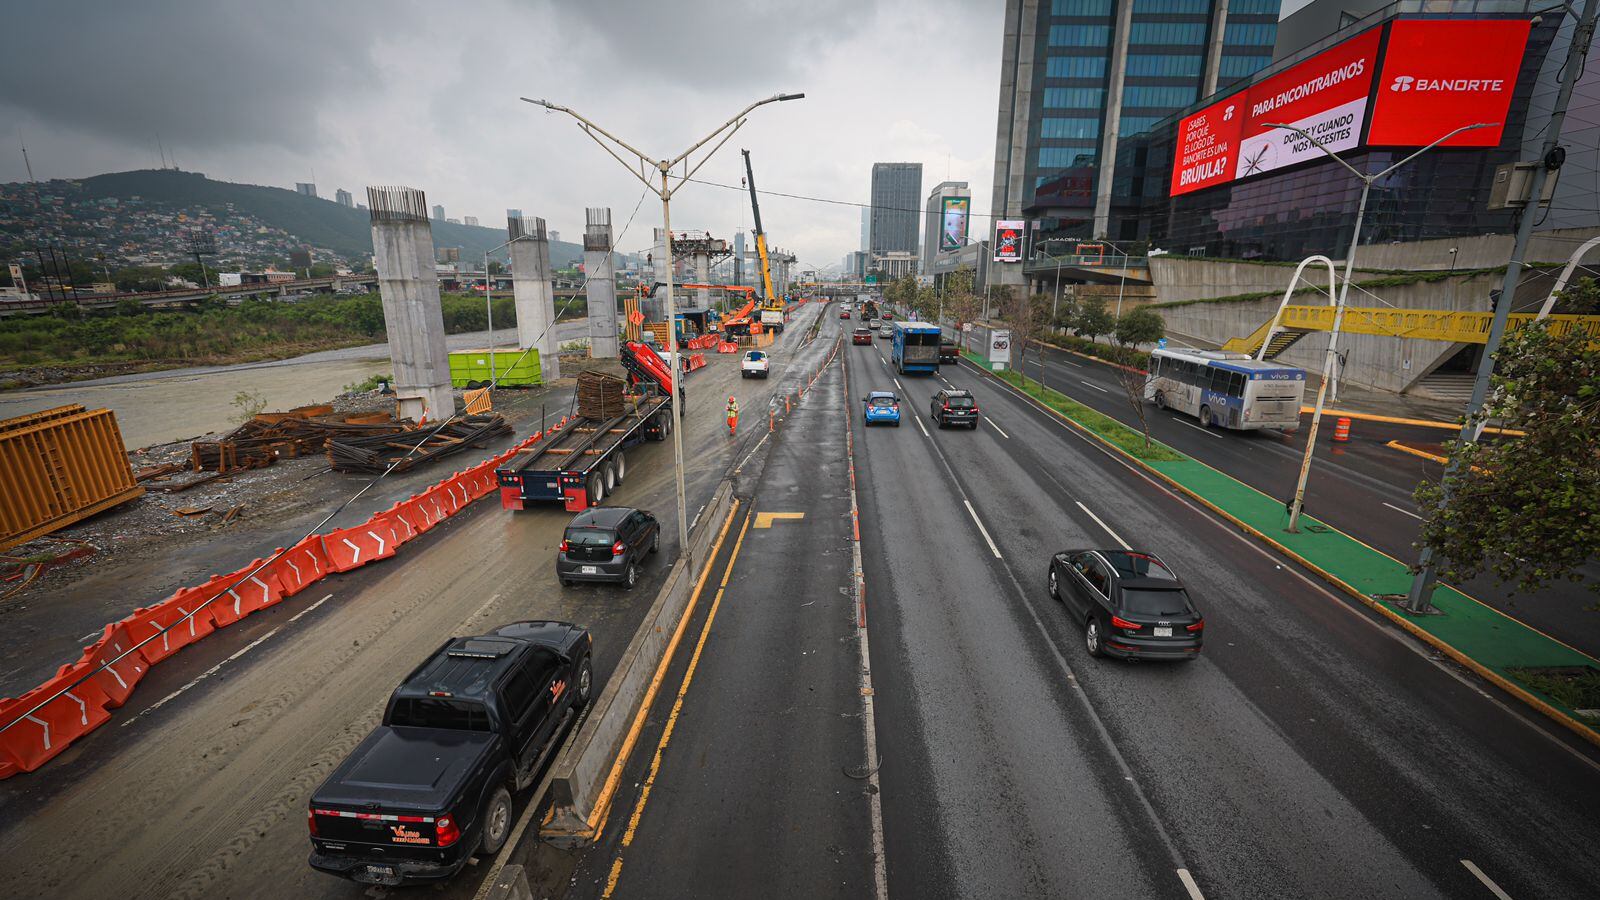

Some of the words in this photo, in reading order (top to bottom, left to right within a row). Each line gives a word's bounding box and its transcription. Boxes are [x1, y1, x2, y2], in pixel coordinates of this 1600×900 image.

[1252, 98, 1274, 118] PARA
[1275, 58, 1365, 108] ENCONTRARNOS
[1416, 79, 1504, 91] BANORTE
[1186, 128, 1197, 143] POR
[1197, 123, 1210, 138] QUÉ
[1187, 115, 1207, 131] ¿SABES
[1317, 113, 1354, 133] CUANDO
[1182, 148, 1208, 166] BANORTE
[1207, 146, 1214, 158] ES
[1214, 142, 1228, 154] UNA
[1184, 144, 1191, 155] EL
[1190, 139, 1207, 153] LOGO
[1207, 134, 1216, 145] DE
[1292, 142, 1309, 154] NOS
[1180, 156, 1227, 186] BRÚJULA?
[1208, 393, 1227, 406] vivo
